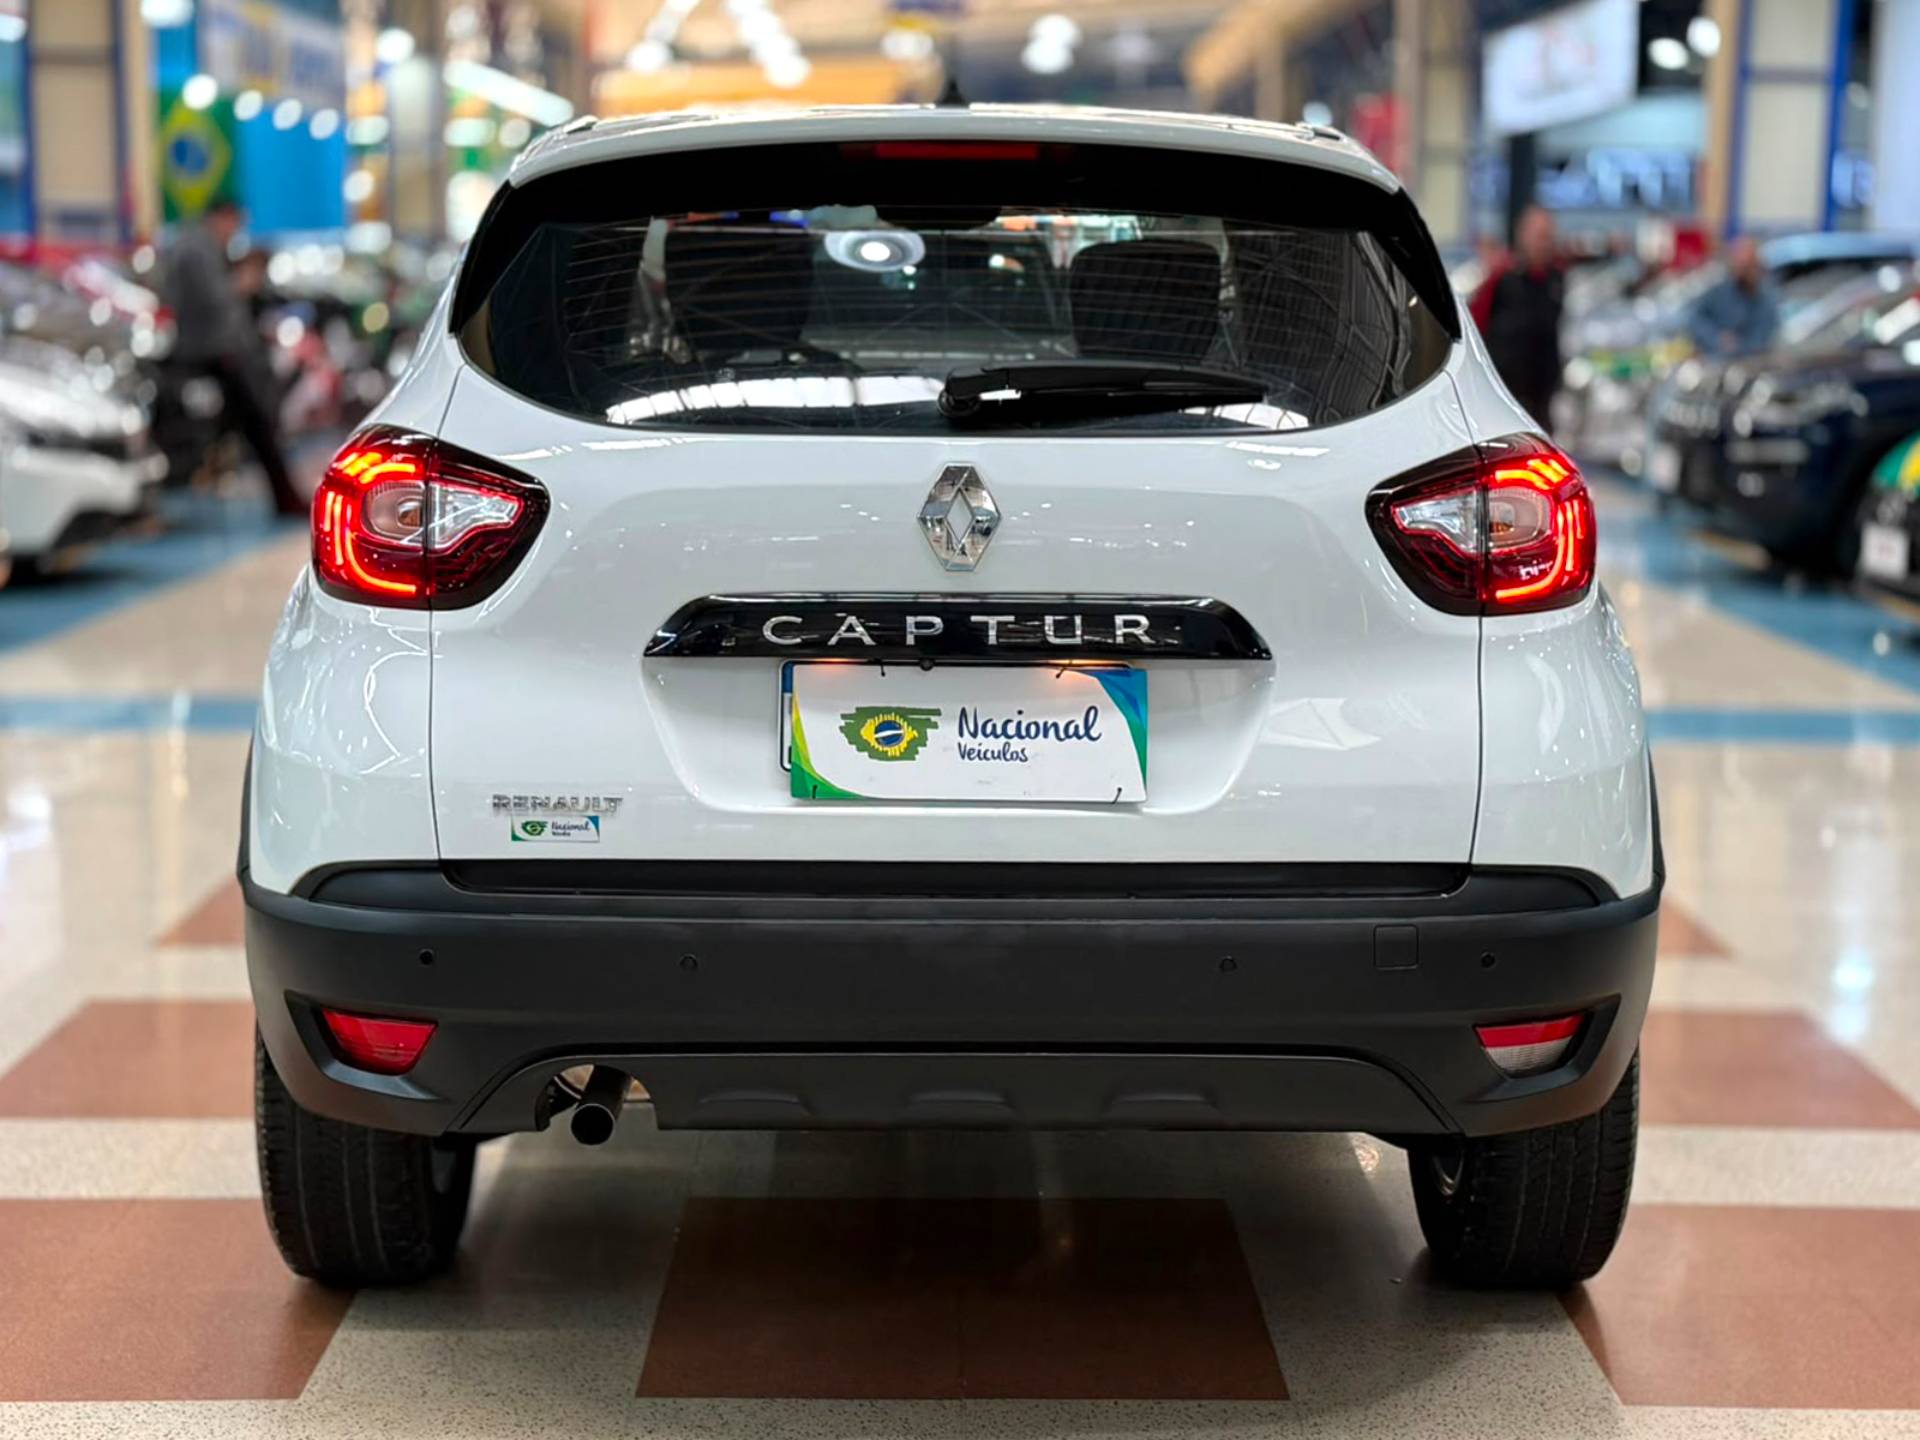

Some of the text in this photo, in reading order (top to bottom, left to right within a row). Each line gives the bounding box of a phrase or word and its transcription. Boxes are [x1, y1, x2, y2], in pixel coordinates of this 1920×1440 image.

[761, 614, 1155, 646] CAPTUR
[958, 705, 1102, 741] Nacional
[492, 794, 624, 814] RENAULT
[551, 820, 591, 832] Nacional
